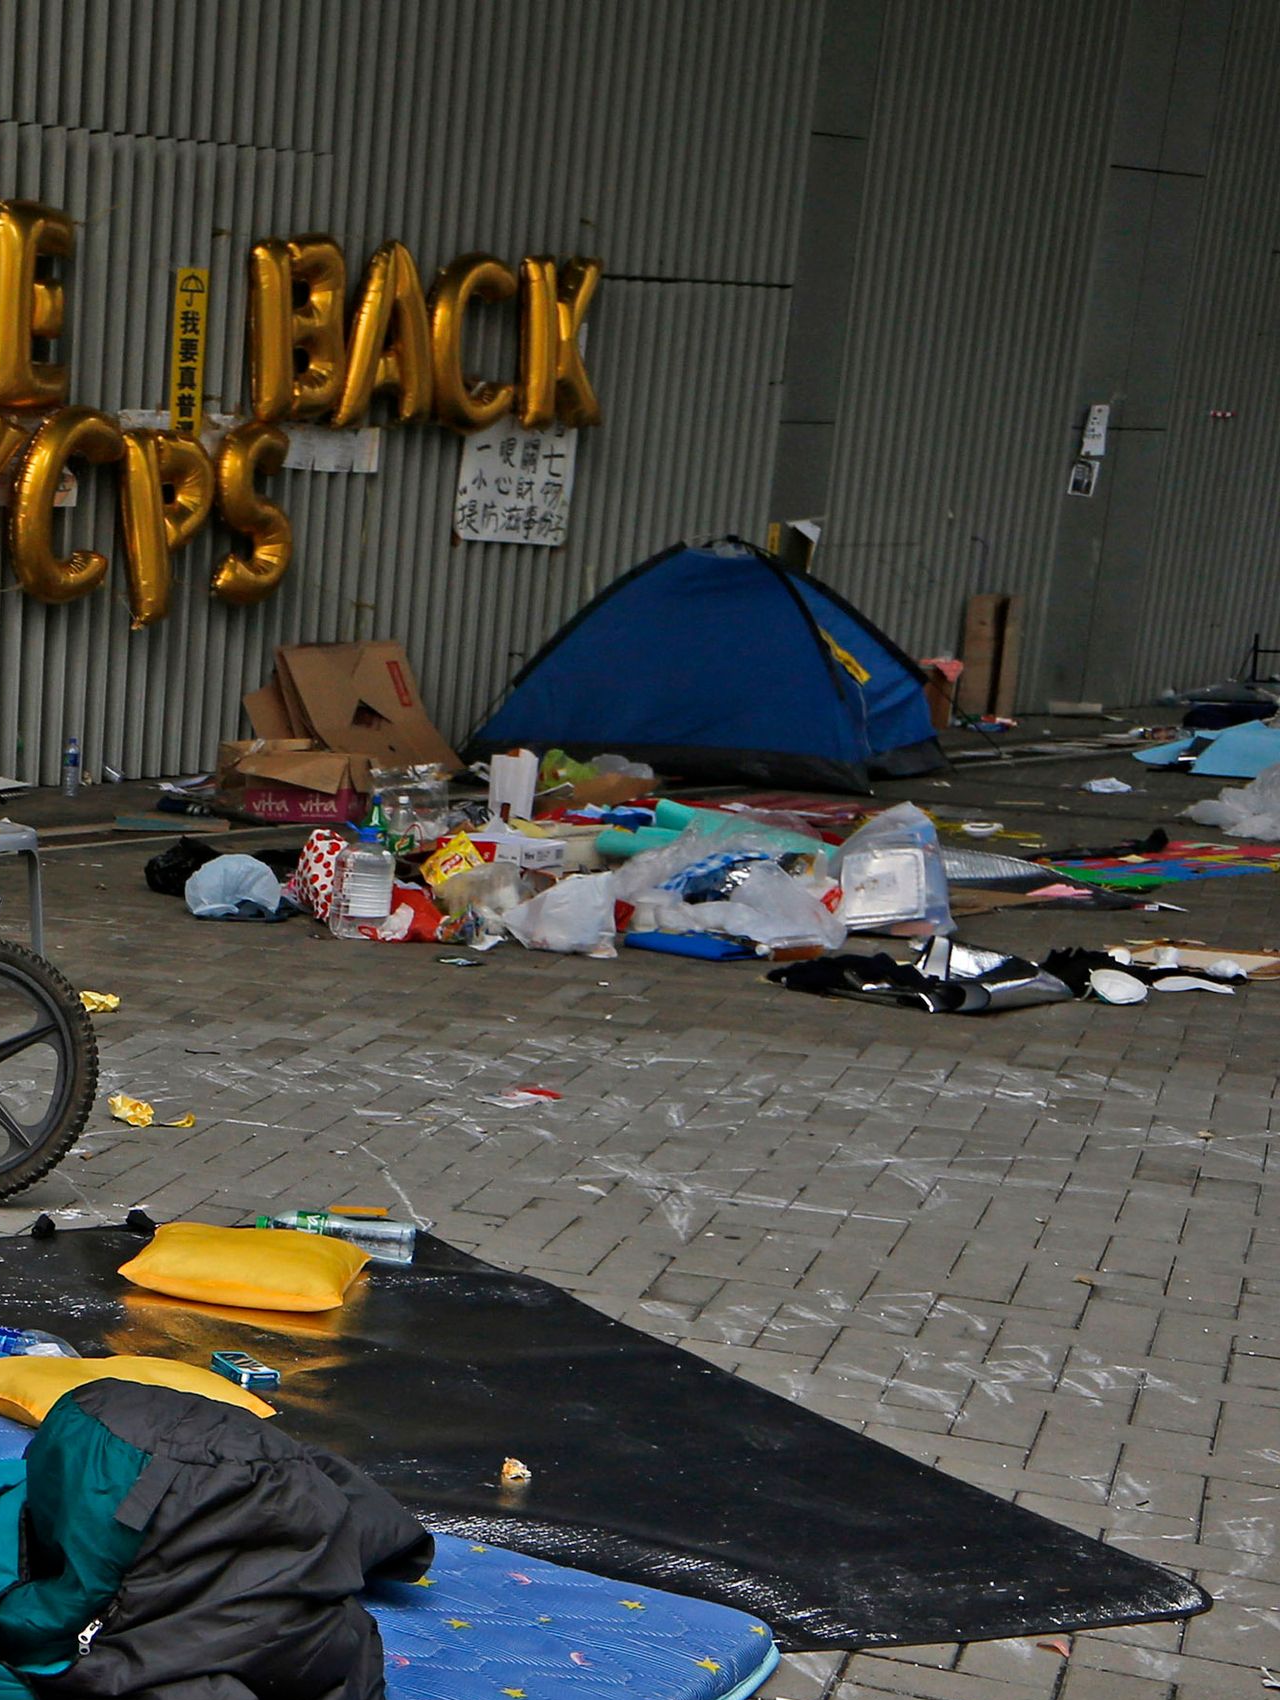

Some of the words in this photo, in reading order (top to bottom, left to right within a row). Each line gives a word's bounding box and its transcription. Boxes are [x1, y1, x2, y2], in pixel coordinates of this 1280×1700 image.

[249, 233, 604, 435] BACK
[252, 792, 290, 813] vita
[299, 793, 338, 813] vita
